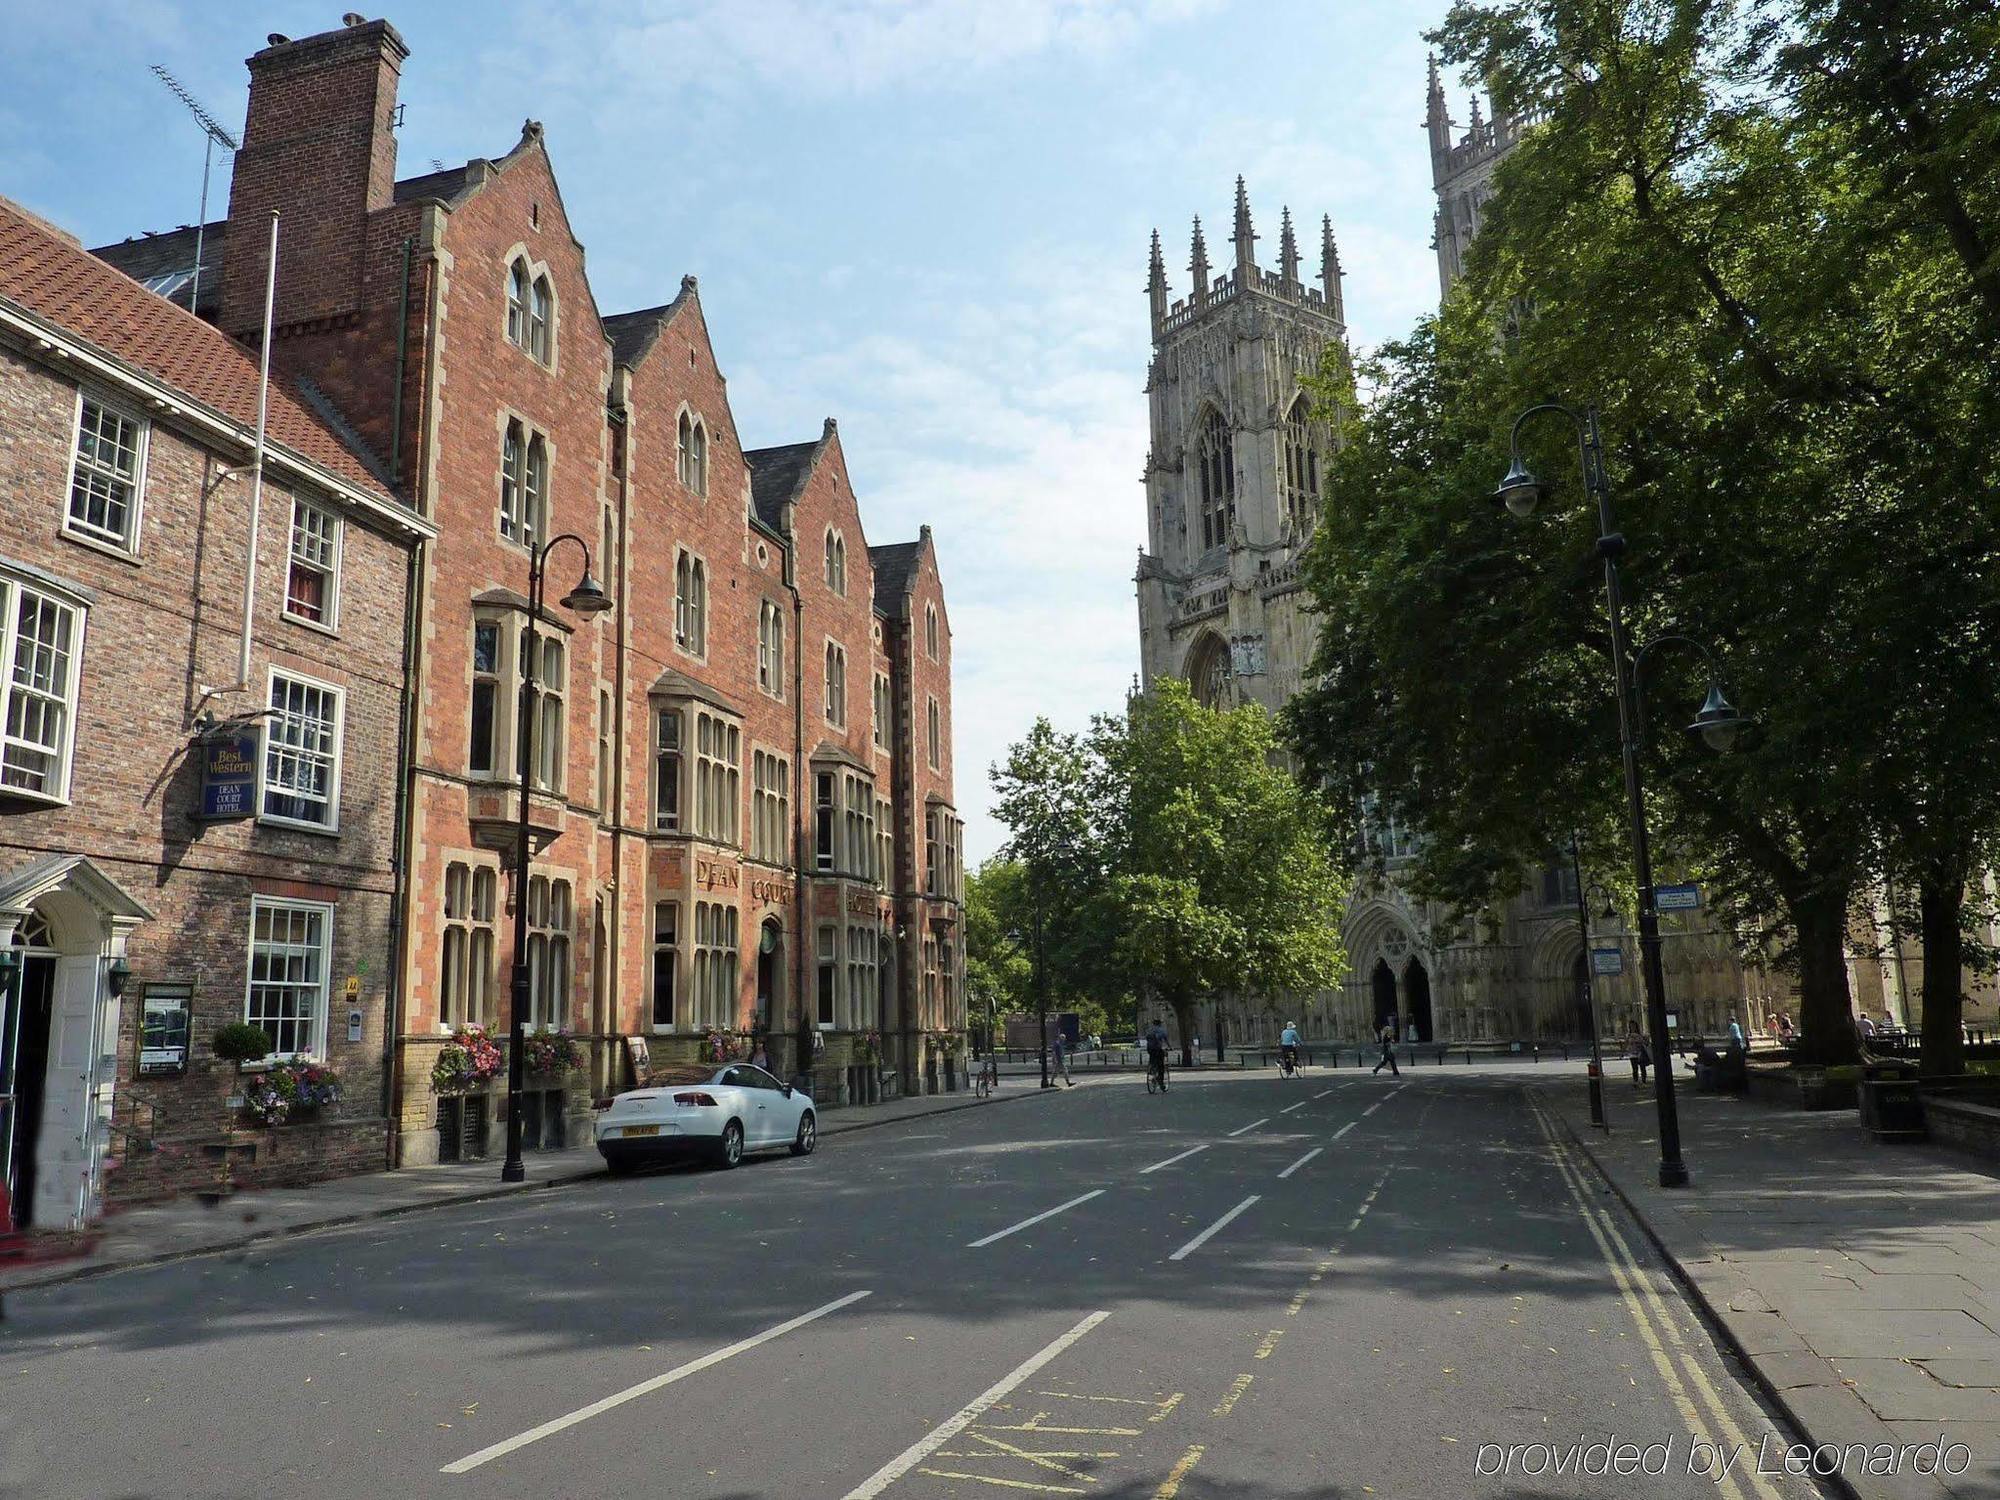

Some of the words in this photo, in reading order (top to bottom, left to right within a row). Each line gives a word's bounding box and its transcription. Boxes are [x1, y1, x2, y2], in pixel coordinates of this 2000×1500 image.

[220, 750, 241, 762] Best
[210, 761, 253, 774] Western
[219, 784, 241, 794] DEAN
[216, 793, 241, 804] COURT
[216, 803, 241, 813] HOTEL
[696, 859, 739, 889] DEAN
